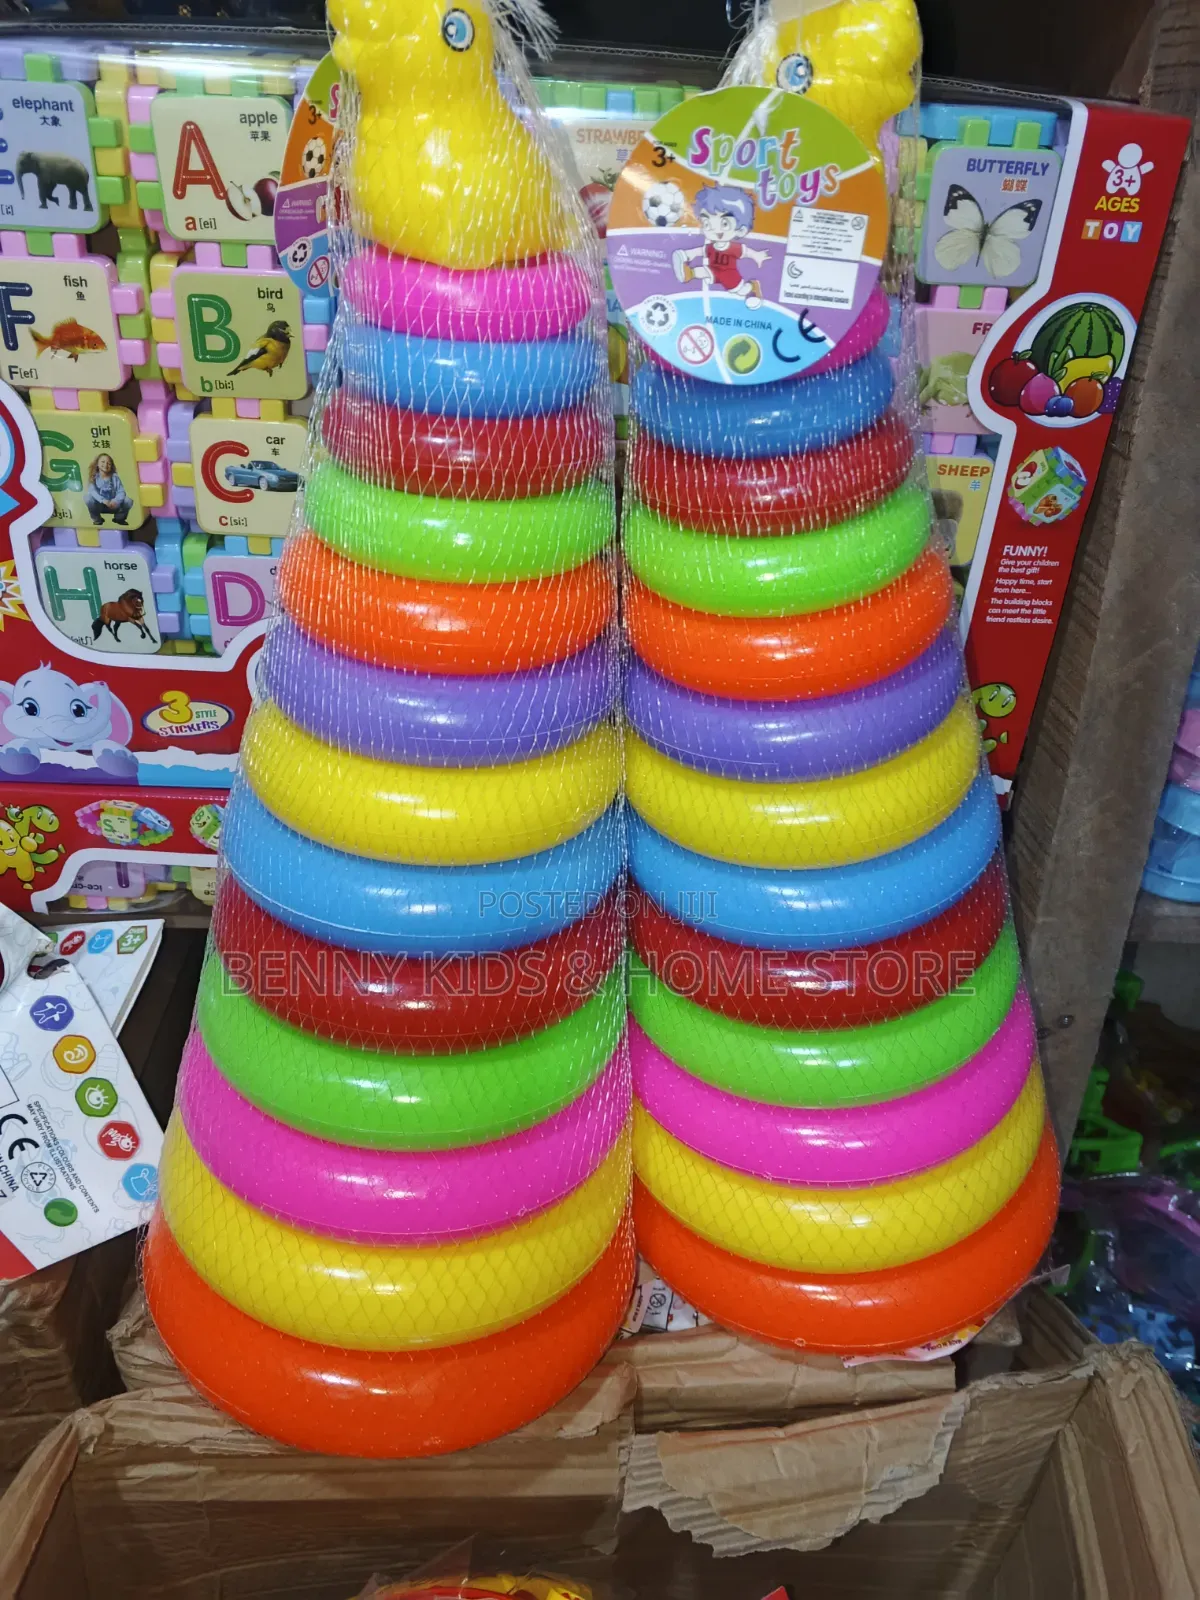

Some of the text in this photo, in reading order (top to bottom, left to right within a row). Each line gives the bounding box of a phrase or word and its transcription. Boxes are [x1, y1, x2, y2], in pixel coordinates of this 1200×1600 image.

[12, 96, 74, 112] elephant
[39, 115, 62, 127] 大象
[239, 111, 278, 127] apple
[308, 104, 322, 125] 3+
[250, 130, 271, 142] 苹果
[173, 120, 228, 200] A
[652, 146, 676, 168] 3+
[689, 127, 800, 175] Sport
[966, 158, 1049, 176] BUTTERFLY
[758, 164, 840, 208] toys
[1112, 169, 1136, 187] 3+
[1094, 196, 1140, 213] AGES
[1083, 220, 1141, 241] TOY
[63, 275, 88, 288] fish
[257, 286, 283, 300] bird
[0, 282, 35, 351] F
[705, 316, 772, 331] MADE IN CHINA
[187, 294, 240, 363] B
[90, 425, 111, 438] girl
[265, 436, 286, 445] car
[40, 430, 83, 493] G
[937, 464, 990, 477] SHEEP
[201, 440, 254, 504] C
[1003, 545, 1048, 557] FUNNY!
[104, 560, 138, 571] horse
[44, 565, 103, 622] H
[211, 571, 266, 627] D
[1004, 598, 1030, 606] building
[159, 690, 217, 724] 3 STYLE
[159, 720, 220, 736] STICKERS
[26, 1102, 77, 1191] MAY VARY FROM ILLUSTRATIONS
[33, 1100, 100, 1214] SPECIFICATIONS COLOURS AND CONTENTS
[0, 1163, 20, 1193] CHINA
